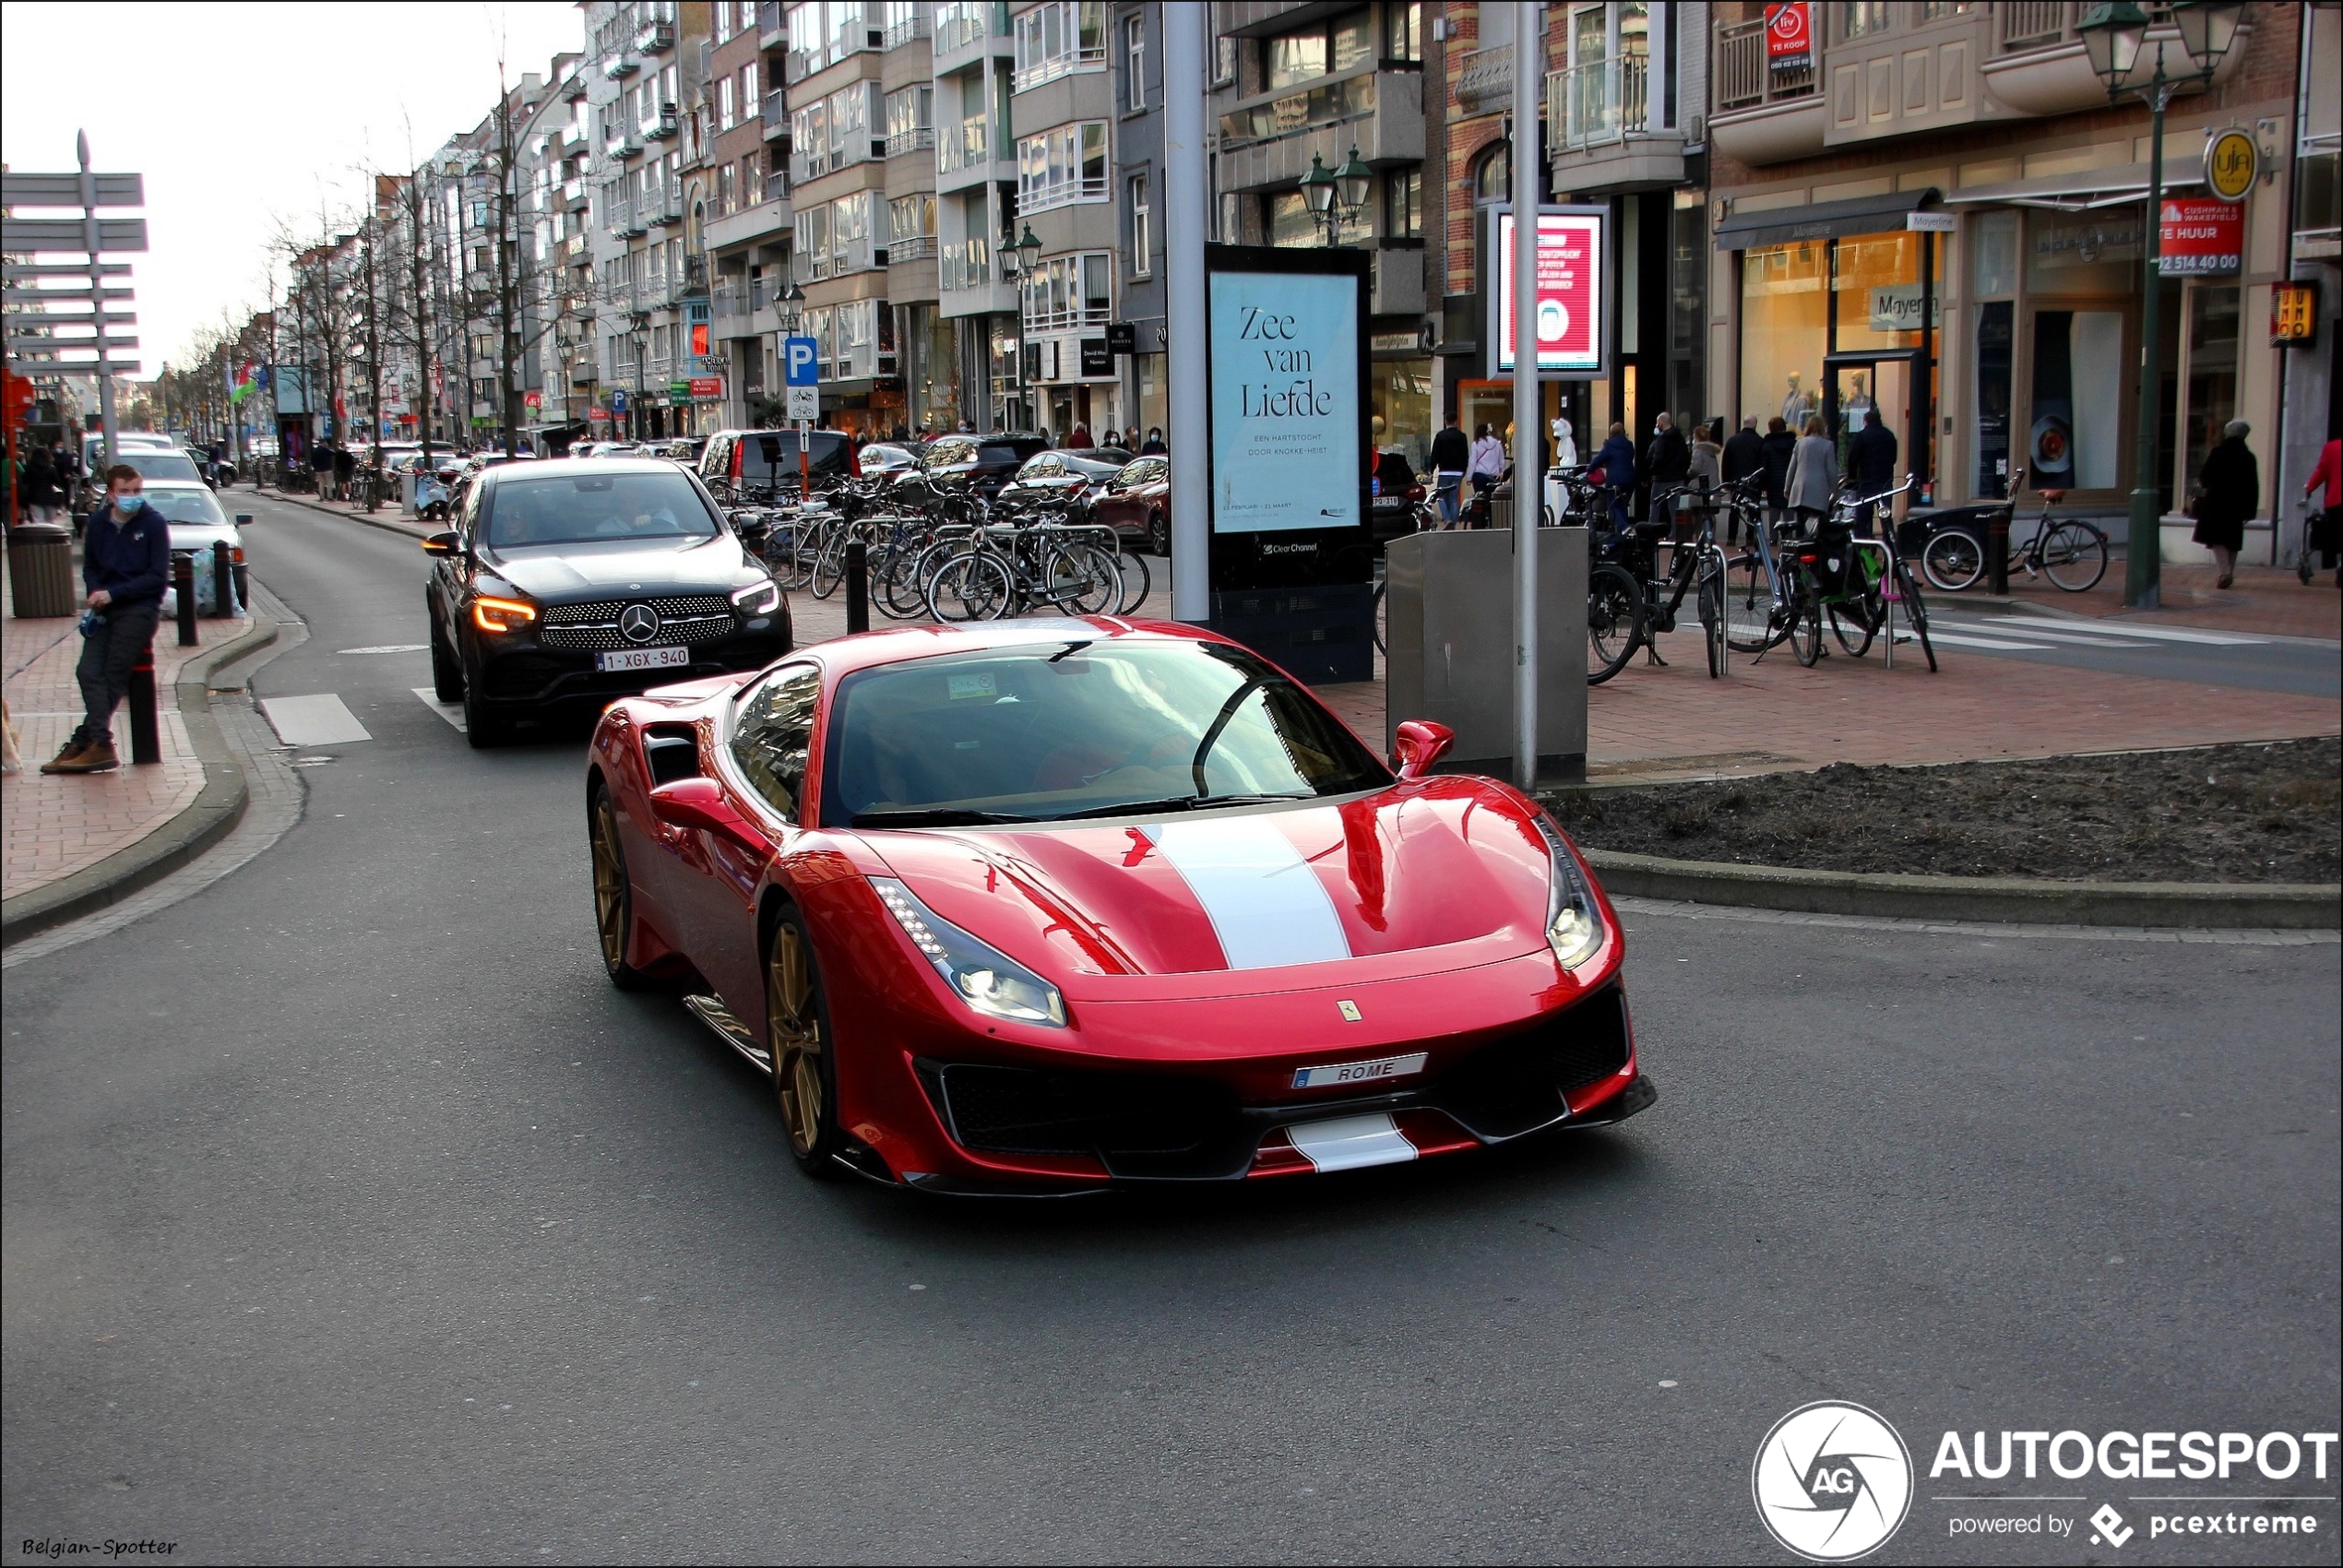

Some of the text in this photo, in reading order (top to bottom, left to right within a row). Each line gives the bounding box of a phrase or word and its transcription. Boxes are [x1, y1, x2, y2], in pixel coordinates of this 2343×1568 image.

[1784, 41, 1805, 50] KOOP
[1914, 217, 1953, 229] Mayerline
[2184, 213, 2237, 221] WAKEFIELD
[2177, 227, 2218, 239] HUUR
[2174, 257, 2195, 269] 514
[2199, 256, 2215, 268] 40
[2219, 255, 2238, 267] 00
[1240, 307, 1299, 340] Zee
[790, 345, 813, 378] P
[1264, 350, 1312, 373] van
[614, 392, 624, 406] P
[1241, 379, 1334, 418] Liefde
[1272, 434, 1322, 442] HARTSTOCHT
[1274, 447, 1327, 456] KNOKKE-HEIST
[1273, 542, 1317, 553] Clear Channel
[608, 650, 686, 669] 1-XGX-940
[1338, 1063, 1395, 1080] ROME
